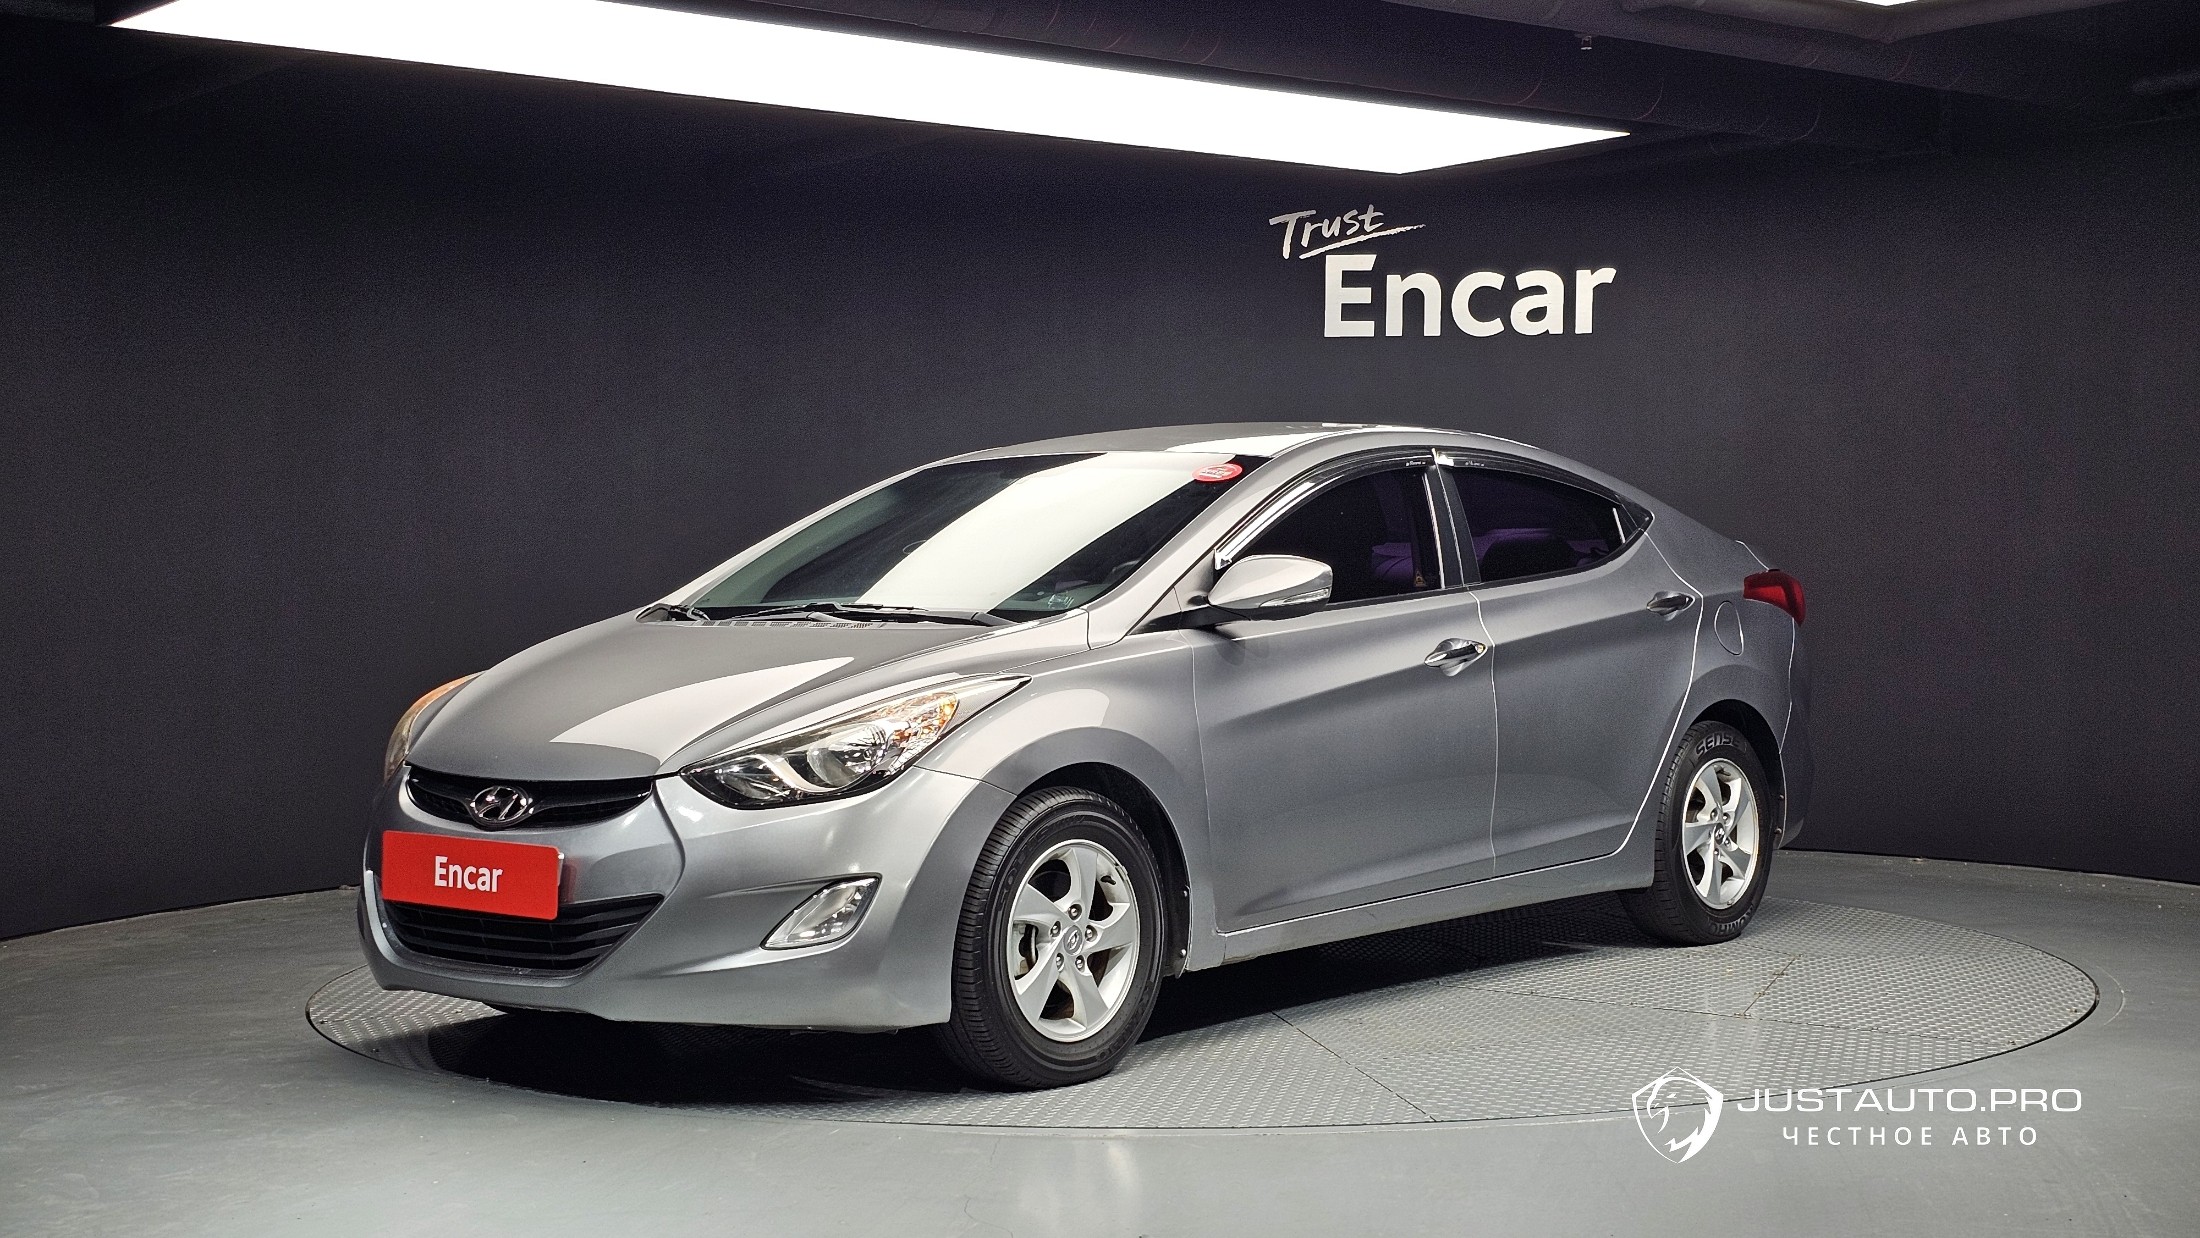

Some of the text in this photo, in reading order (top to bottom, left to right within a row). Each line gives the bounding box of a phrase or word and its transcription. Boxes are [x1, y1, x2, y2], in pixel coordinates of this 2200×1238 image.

[1269, 204, 1384, 260] Trust
[1324, 254, 1616, 337] Encar
[435, 855, 503, 892] Encar
